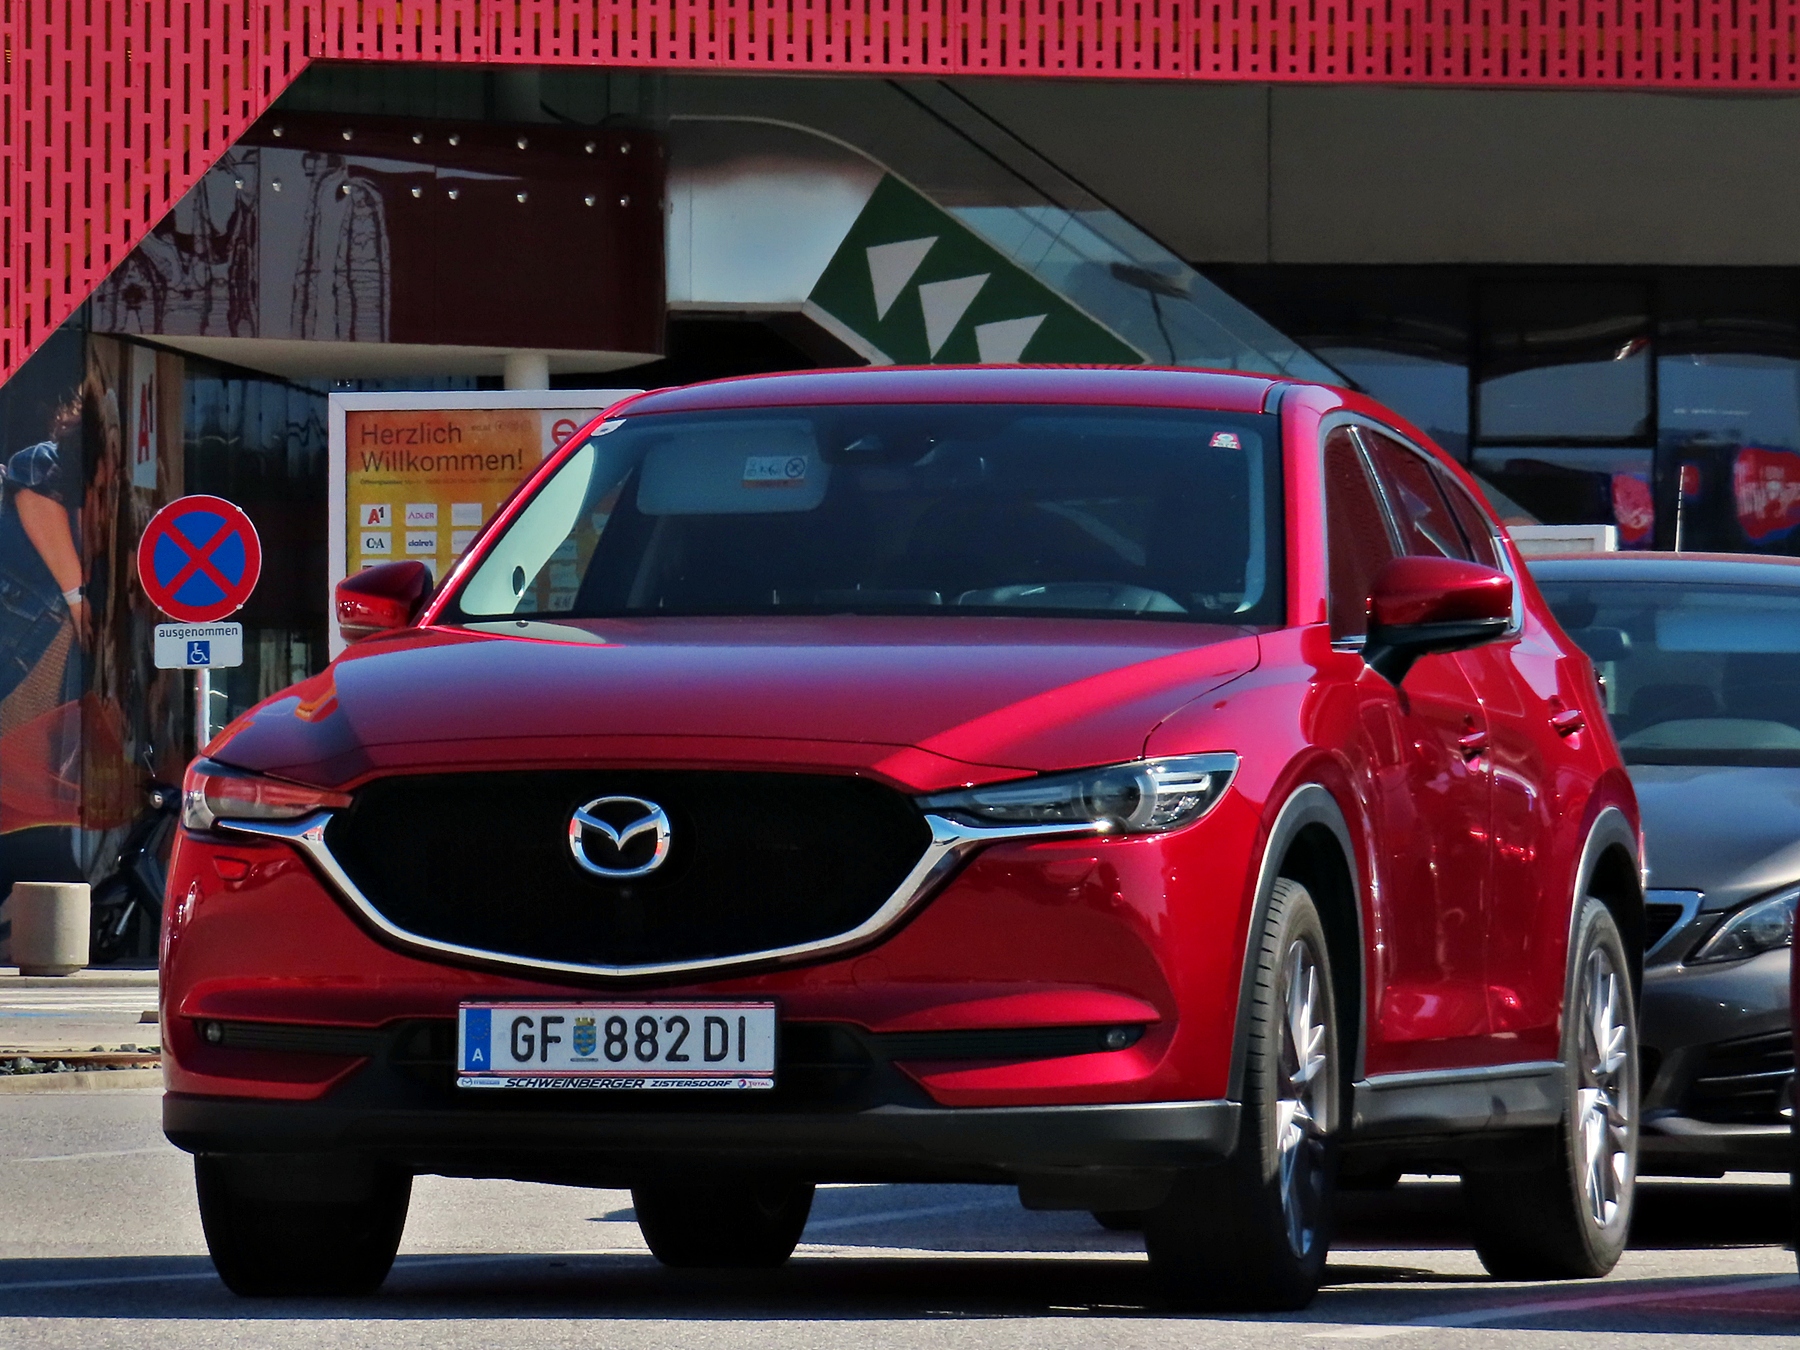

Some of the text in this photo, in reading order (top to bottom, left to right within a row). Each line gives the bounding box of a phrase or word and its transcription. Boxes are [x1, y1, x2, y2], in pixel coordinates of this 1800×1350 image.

[137, 373, 154, 466] A1
[361, 422, 462, 445] Herzlich
[360, 448, 523, 473] Willkommen!
[367, 506, 385, 525] A1
[158, 626, 238, 638] ausgenommen
[510, 1015, 747, 1063] GF 882 DI
[472, 1048, 484, 1062] A
[504, 1078, 646, 1089] SCHWEINBERGER
